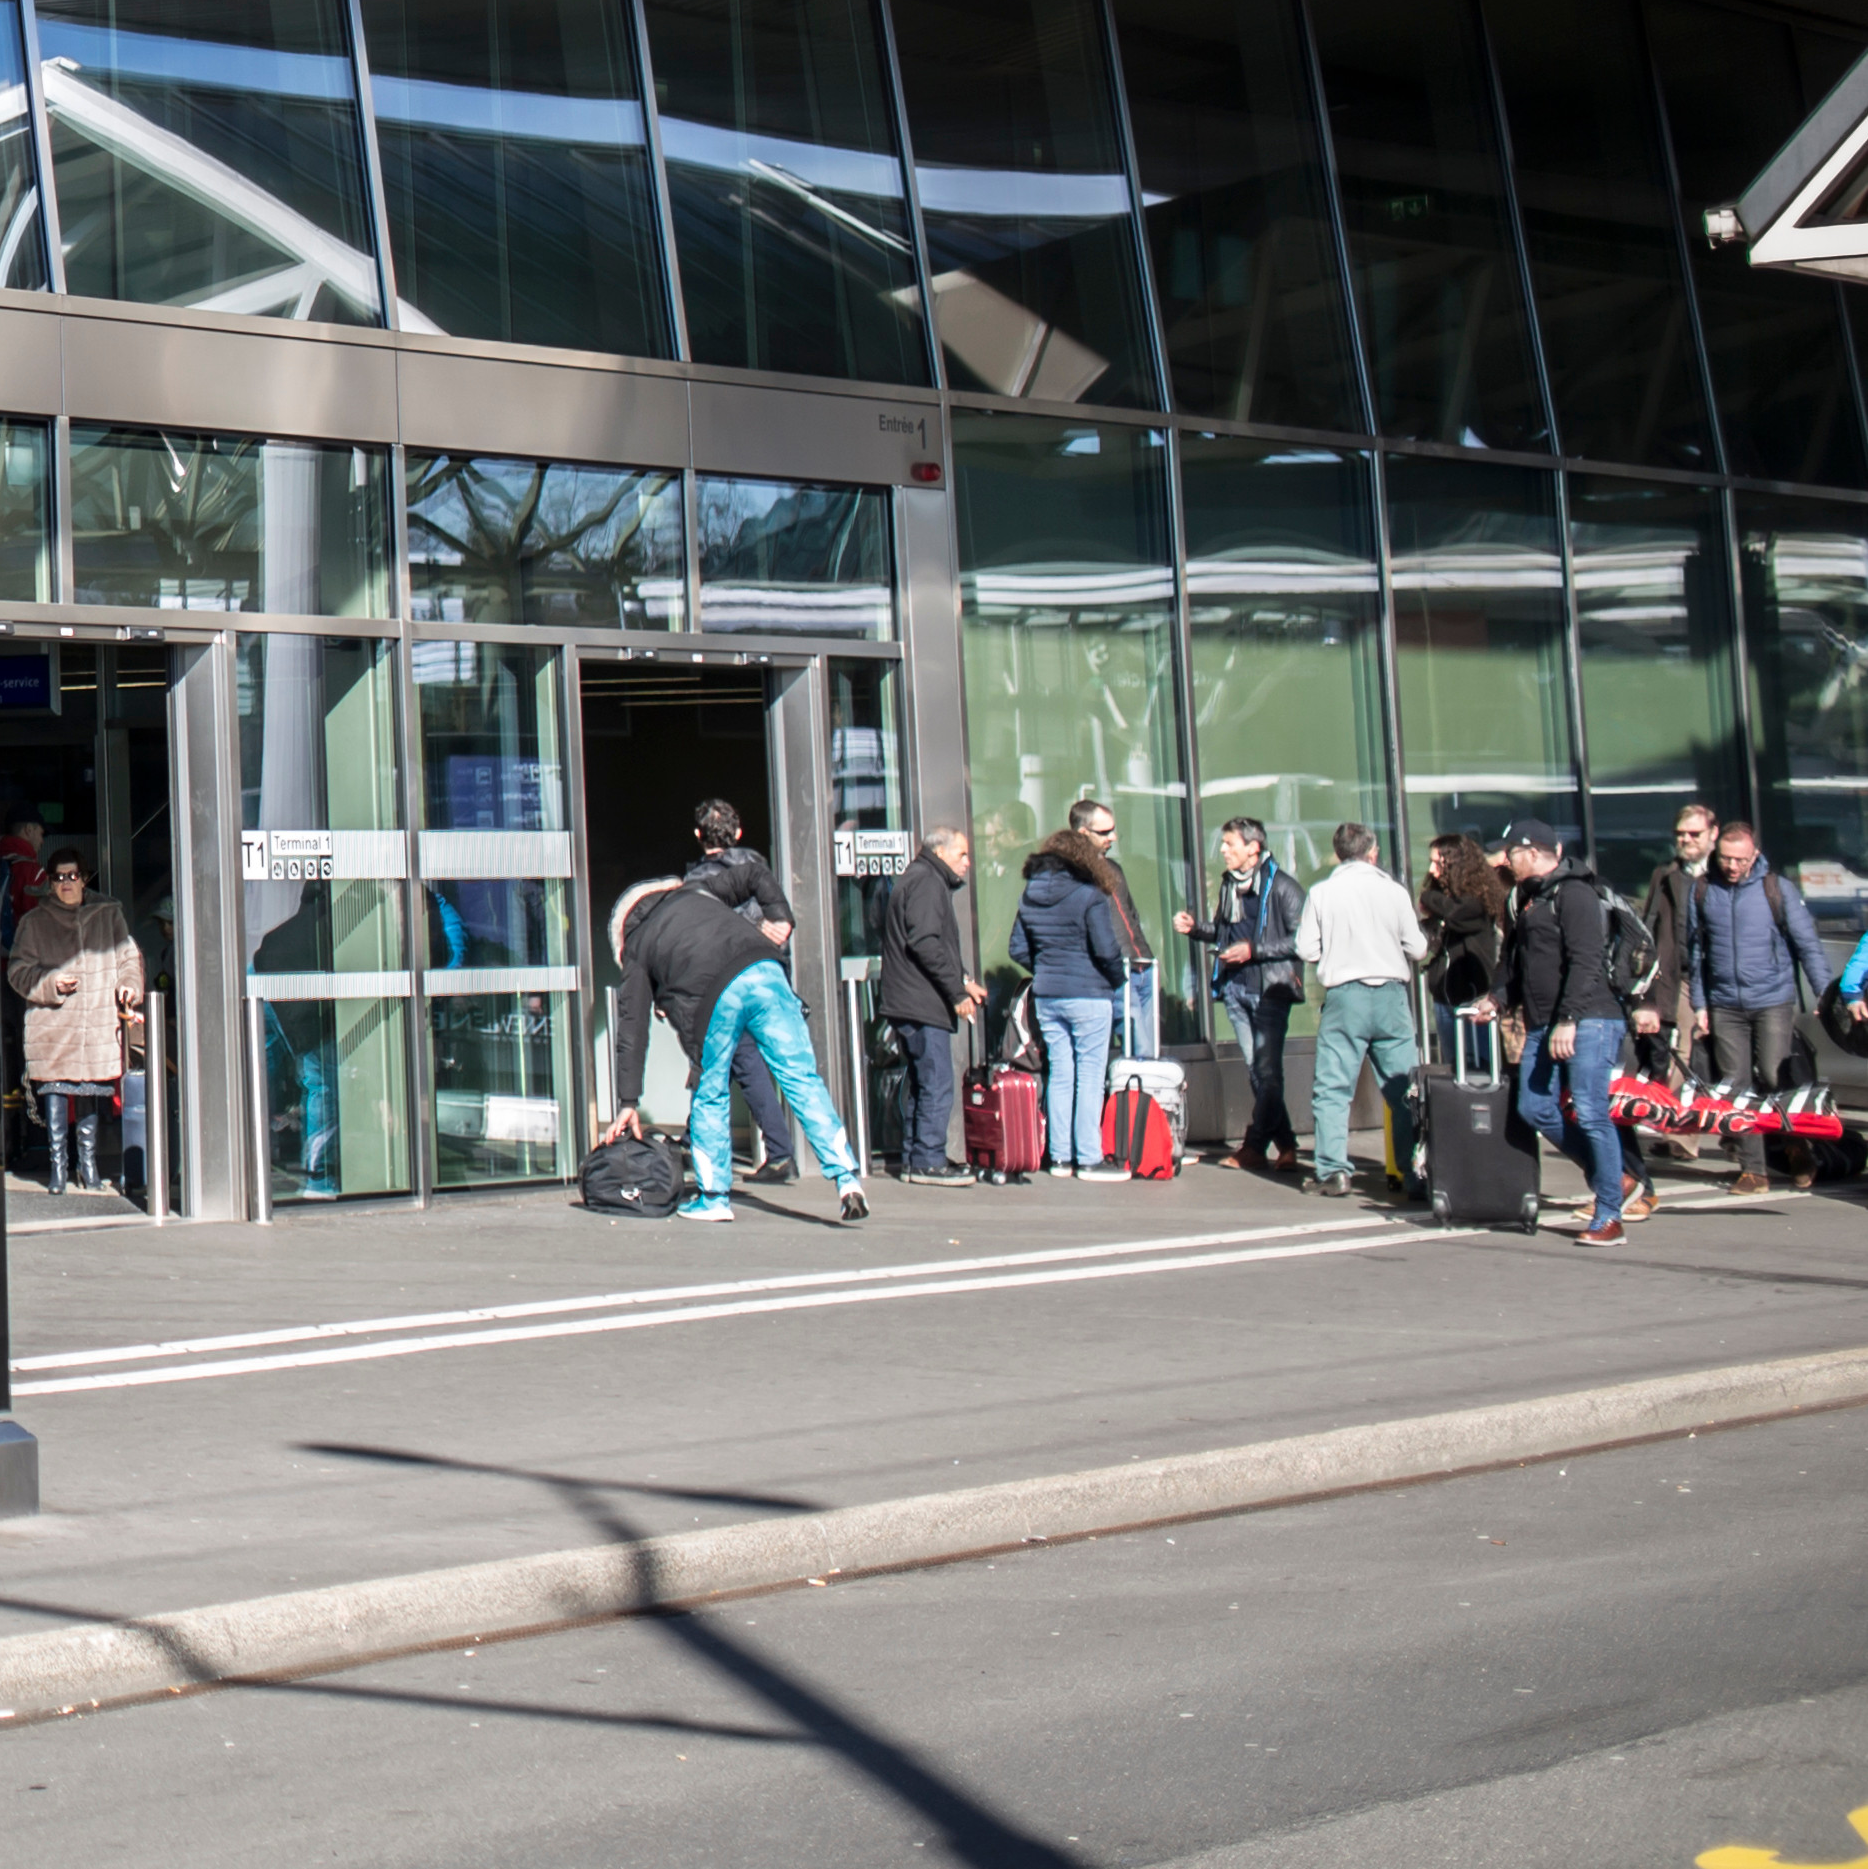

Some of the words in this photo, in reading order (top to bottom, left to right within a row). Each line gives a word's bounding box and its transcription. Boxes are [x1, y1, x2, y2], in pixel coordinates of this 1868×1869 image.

[878, 414, 914, 434] Entrée
[917, 417, 926, 450] 1
[241, 841, 265, 868] T1
[273, 835, 322, 851] Terminal
[325, 836, 330, 851] 1
[833, 841, 852, 865] T1
[858, 835, 896, 849] Terminal
[898, 836, 903, 849] 1
[1608, 1094, 1758, 1136] OMIC
